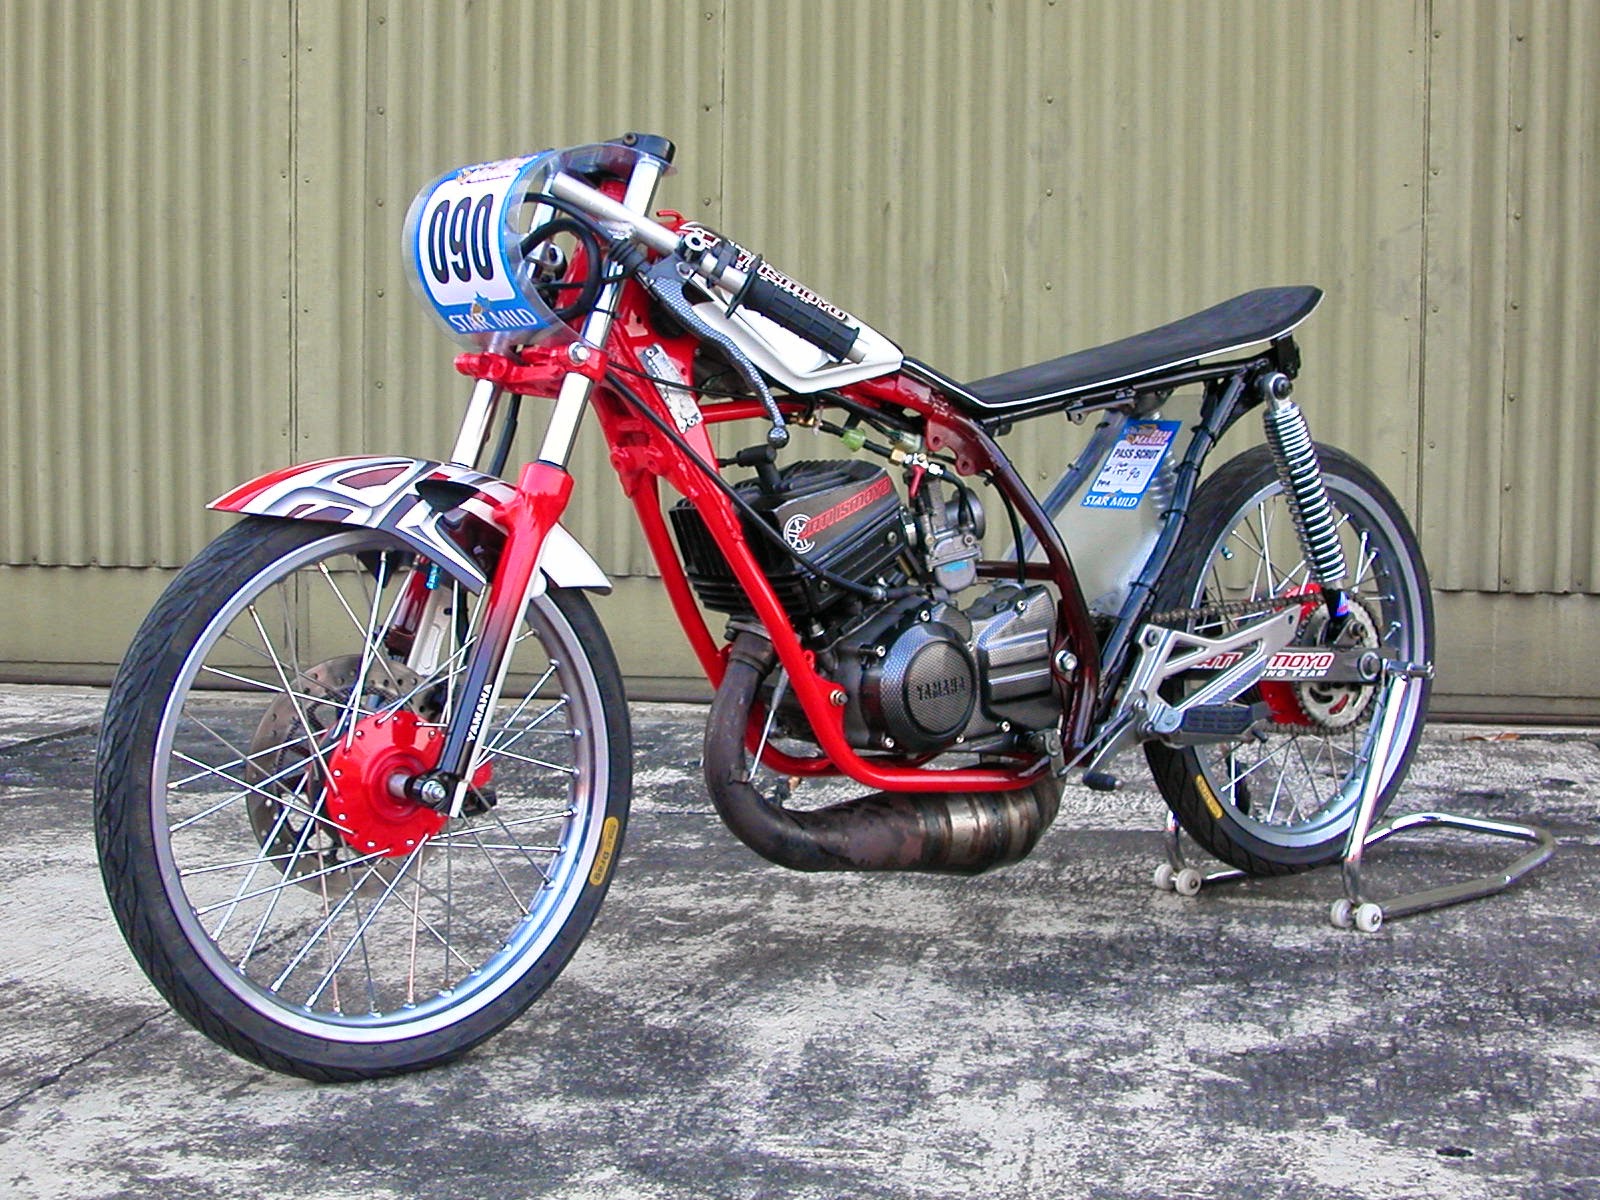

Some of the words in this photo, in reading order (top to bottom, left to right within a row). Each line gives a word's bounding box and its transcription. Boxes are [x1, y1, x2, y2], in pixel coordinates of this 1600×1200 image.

[428, 193, 494, 285] 090
[448, 313, 492, 334] STAR
[493, 307, 539, 329] MILD
[1113, 449, 1133, 459] PASS
[1134, 449, 1161, 460] SCRUT
[1083, 495, 1109, 506] STAR
[1109, 496, 1138, 507] MILD
[1292, 669, 1327, 677] TEAM
[917, 676, 966, 701] YAMAHA
[466, 683, 493, 742] YAMAHA
